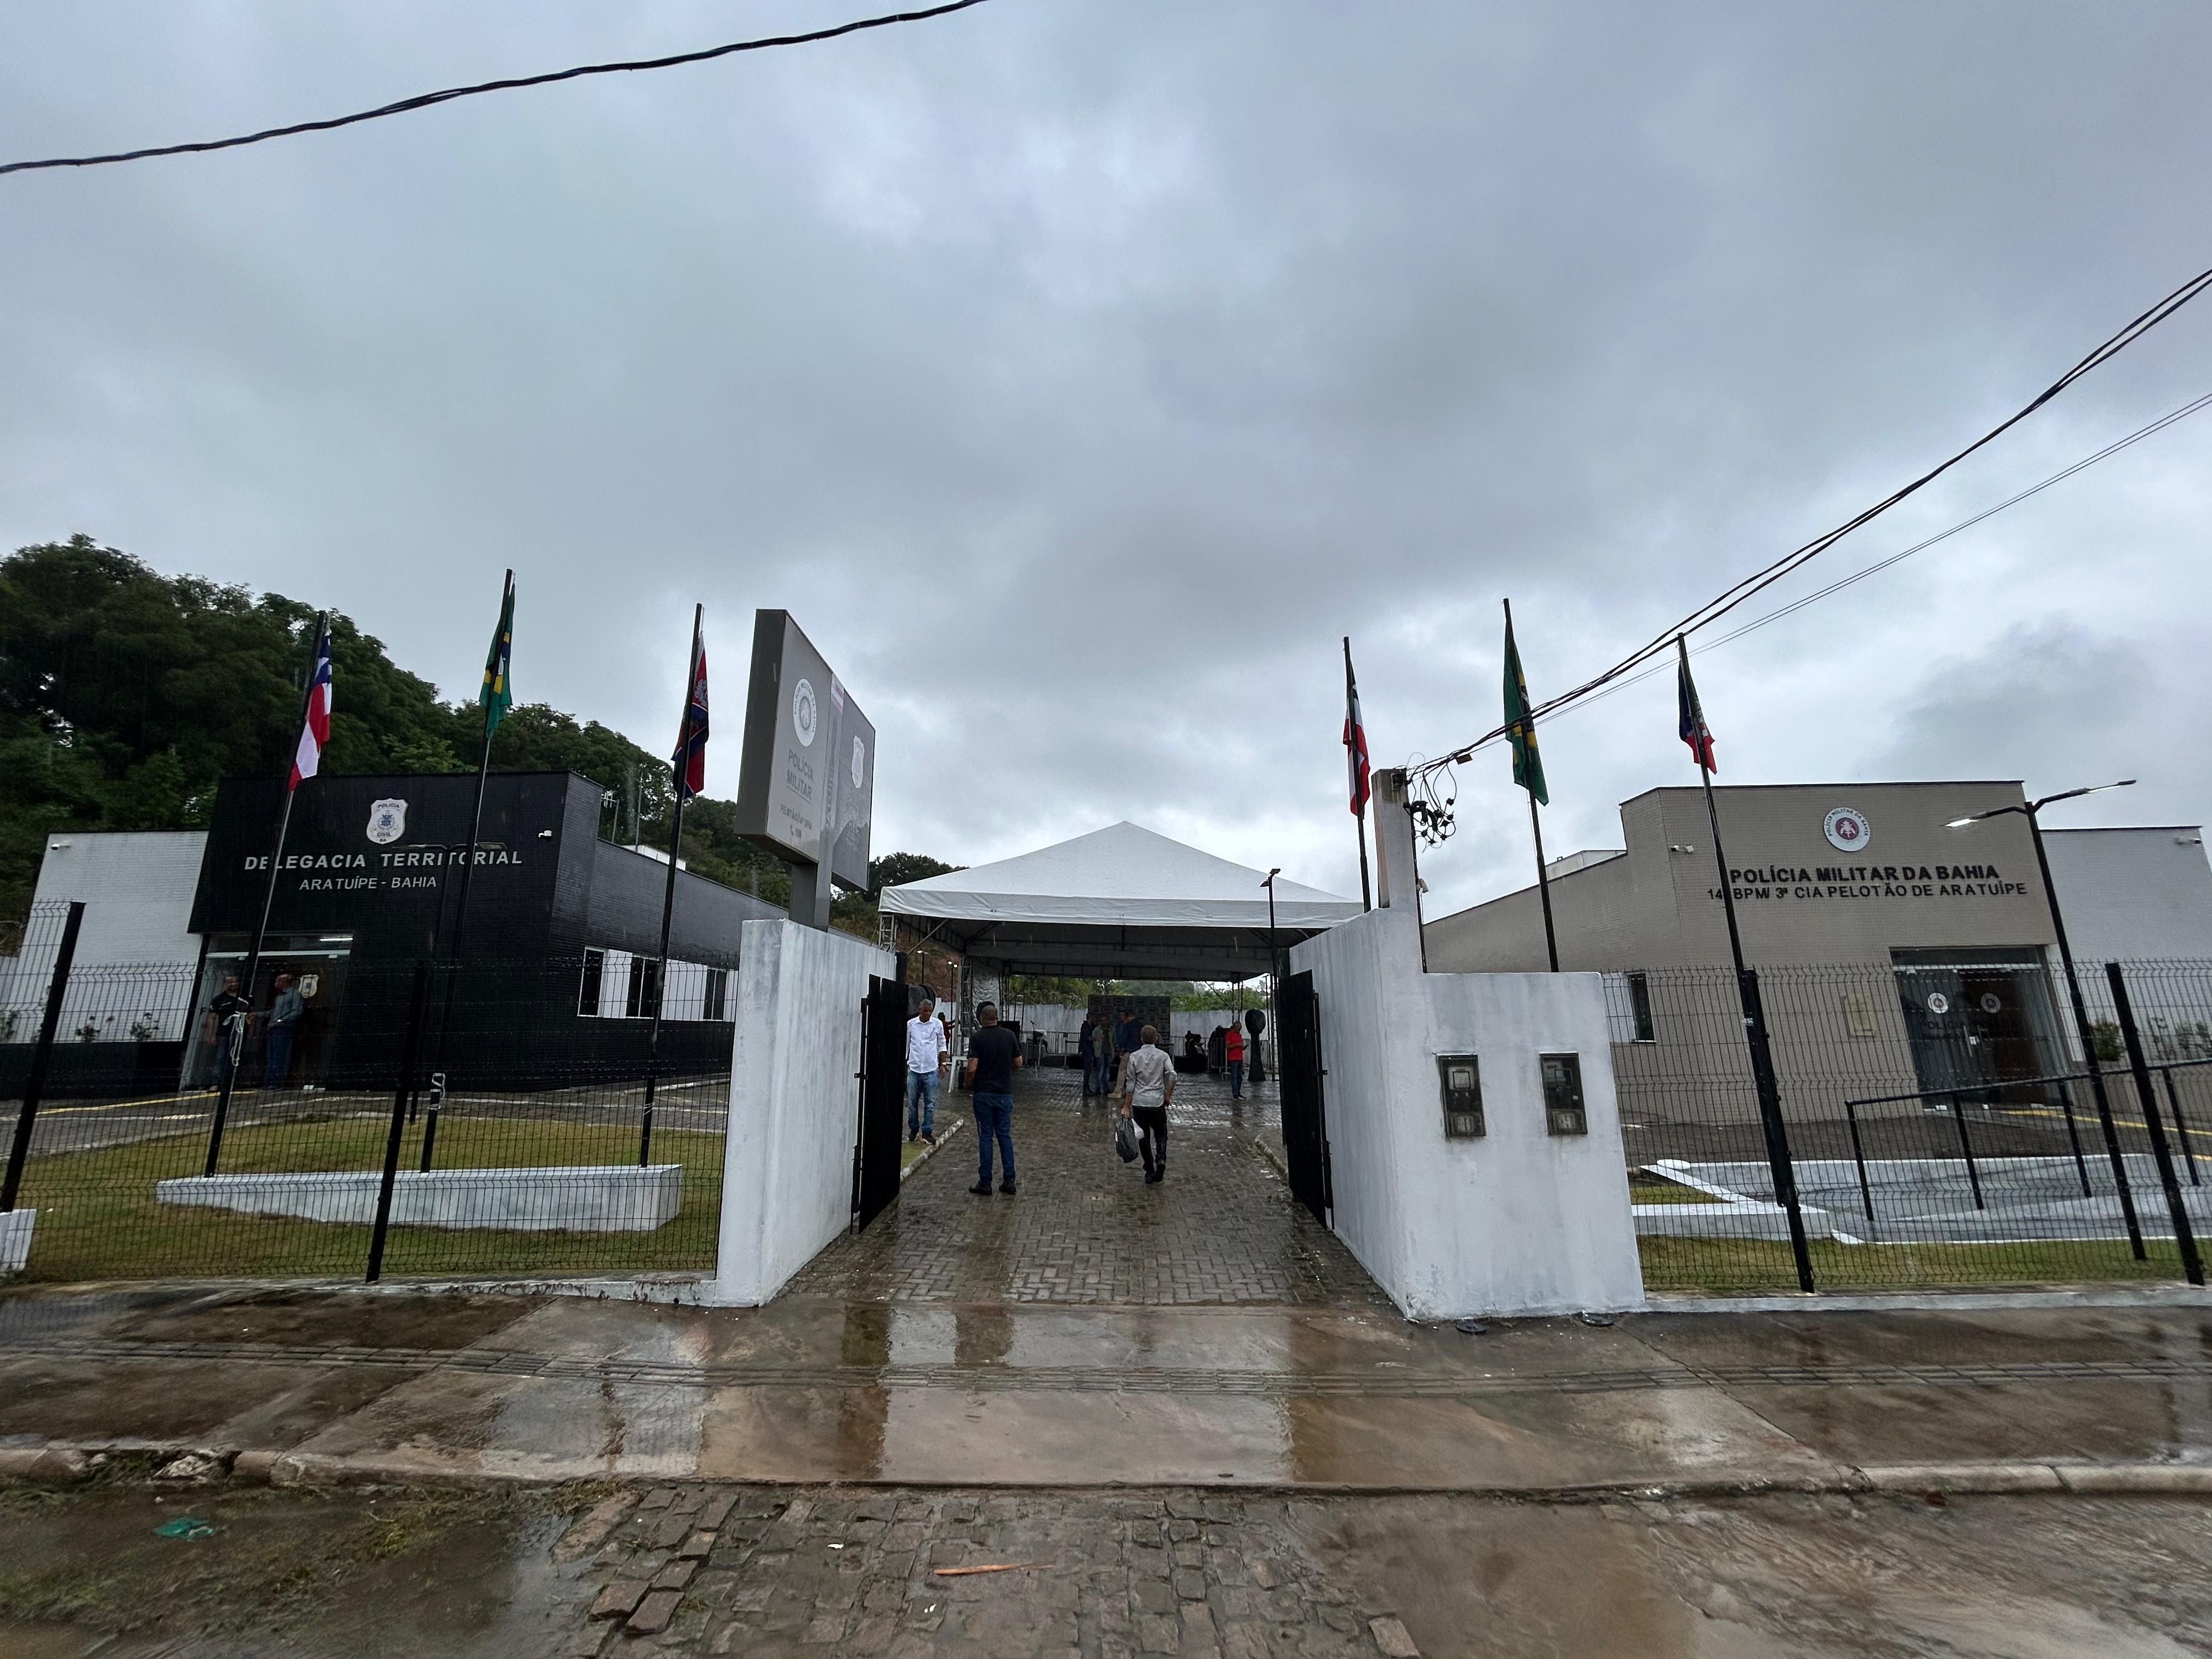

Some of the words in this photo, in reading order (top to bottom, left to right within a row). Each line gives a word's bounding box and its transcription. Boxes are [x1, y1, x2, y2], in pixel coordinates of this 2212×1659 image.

[788, 748, 814, 782] POLÍCIA
[786, 769, 812, 800] MILITAR
[299, 875, 378, 890] ARATUÍPE
[391, 877, 437, 888] BAHIA
[1730, 865, 1812, 883] POLÍCIA
[1816, 866, 1899, 882] MILITAR
[1902, 866, 1932, 881] DA
[1936, 865, 2000, 879] BAHIA
[1795, 886, 1824, 898] CIA
[1827, 882, 1907, 898] PELOTÃO
[1911, 884, 1934, 896] DE
[1940, 881, 2027, 896] ARATUÍPE
